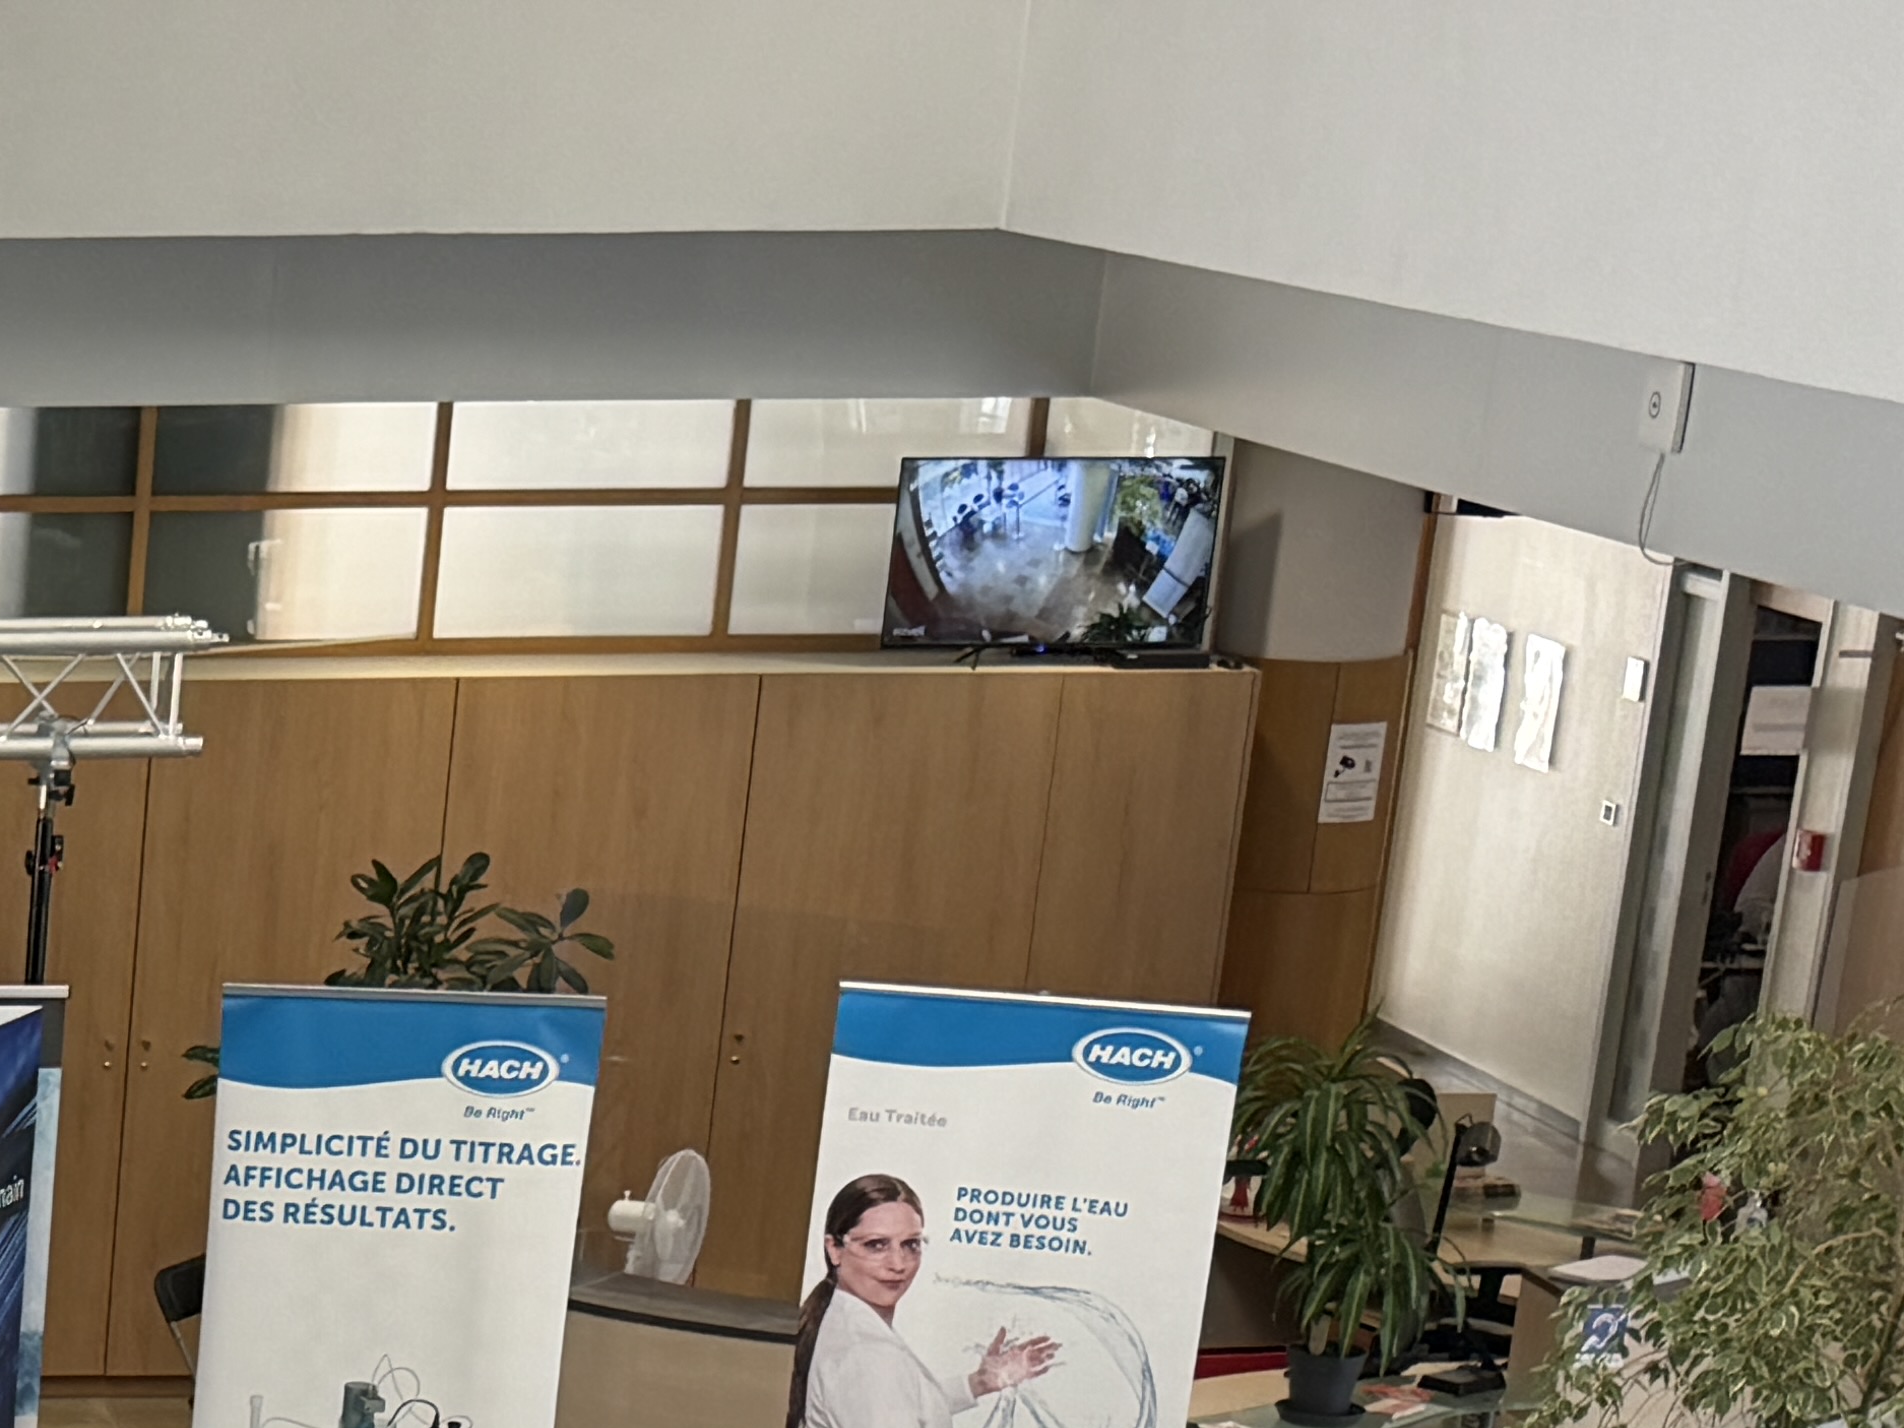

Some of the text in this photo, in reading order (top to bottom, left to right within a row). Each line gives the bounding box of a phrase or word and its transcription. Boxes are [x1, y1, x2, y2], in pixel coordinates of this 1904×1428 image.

[457, 1058, 544, 1079] HACH
[1088, 1044, 1176, 1069] HACH
[848, 1107, 947, 1127] Eau Traitée
[227, 1130, 581, 1167] SIMPLICITÉ DU TITRAGE.
[223, 1164, 505, 1199] AFFICHAGE DIRECT
[222, 1197, 456, 1232] DES RÉSULTATS.
[957, 1186, 1128, 1218] PRODUIRE L'EAU
[954, 1207, 1079, 1233] DONT VOUS
[950, 1228, 1092, 1256] AVEZ BESOIN.
